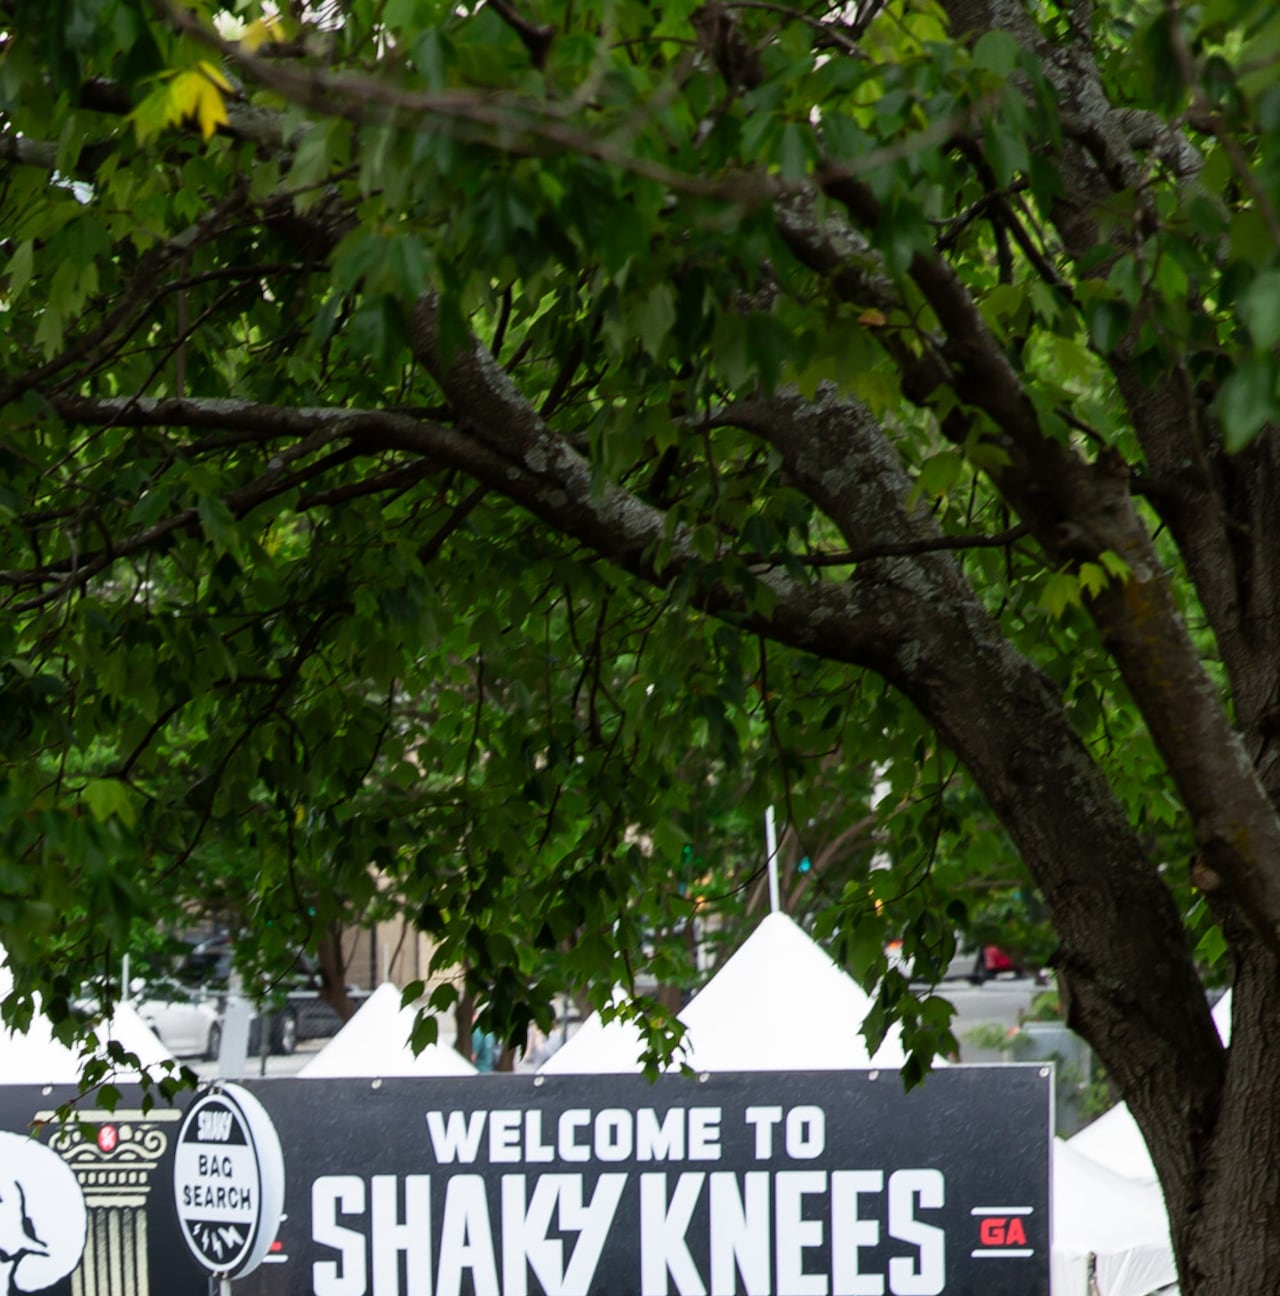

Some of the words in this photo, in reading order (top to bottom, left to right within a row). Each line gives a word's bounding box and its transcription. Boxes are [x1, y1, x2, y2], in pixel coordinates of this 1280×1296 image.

[426, 1107, 721, 1163] WELCOME
[746, 1106, 825, 1159] TO
[198, 1154, 233, 1178] BAG
[183, 1184, 251, 1209] SEARCH
[640, 1169, 945, 1296] KNEES
[980, 1218, 1027, 1245] GA
